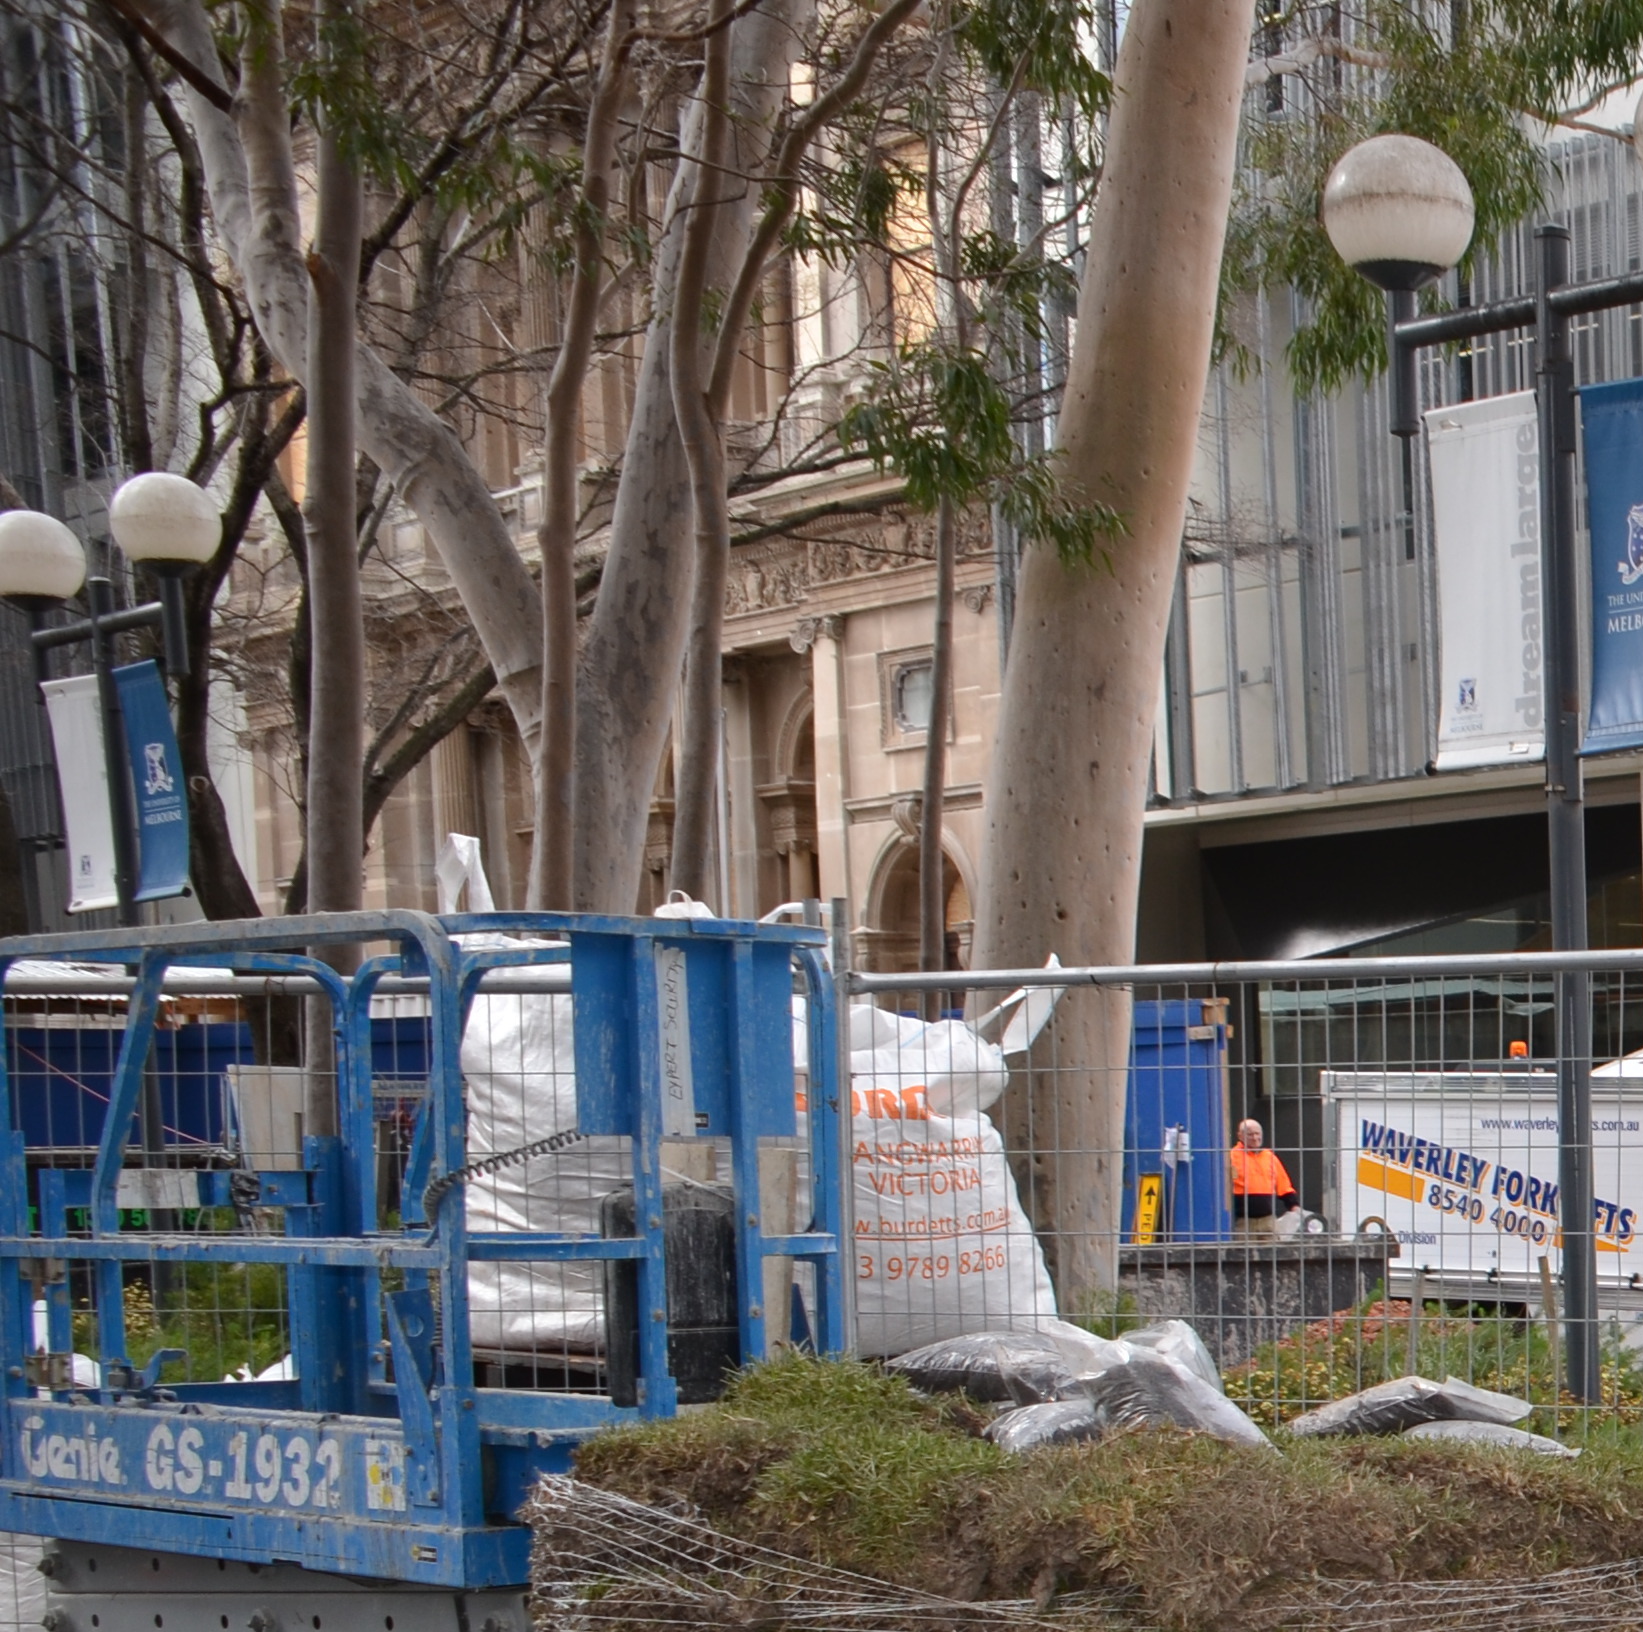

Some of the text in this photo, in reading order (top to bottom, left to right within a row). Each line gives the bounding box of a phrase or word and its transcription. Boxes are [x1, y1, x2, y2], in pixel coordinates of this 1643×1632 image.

[1607, 595, 1624, 607] THE
[1361, 1119, 1491, 1195] WAVERLEY
[868, 1168, 982, 1196] VICTORIA
[1428, 1183, 1546, 1245] 8540 4000
[1398, 1230, 1437, 1245] Division
[887, 1255, 949, 1281] 9789
[959, 1245, 1005, 1275] 8266
[20, 1415, 341, 1508] Genie GS-1932
